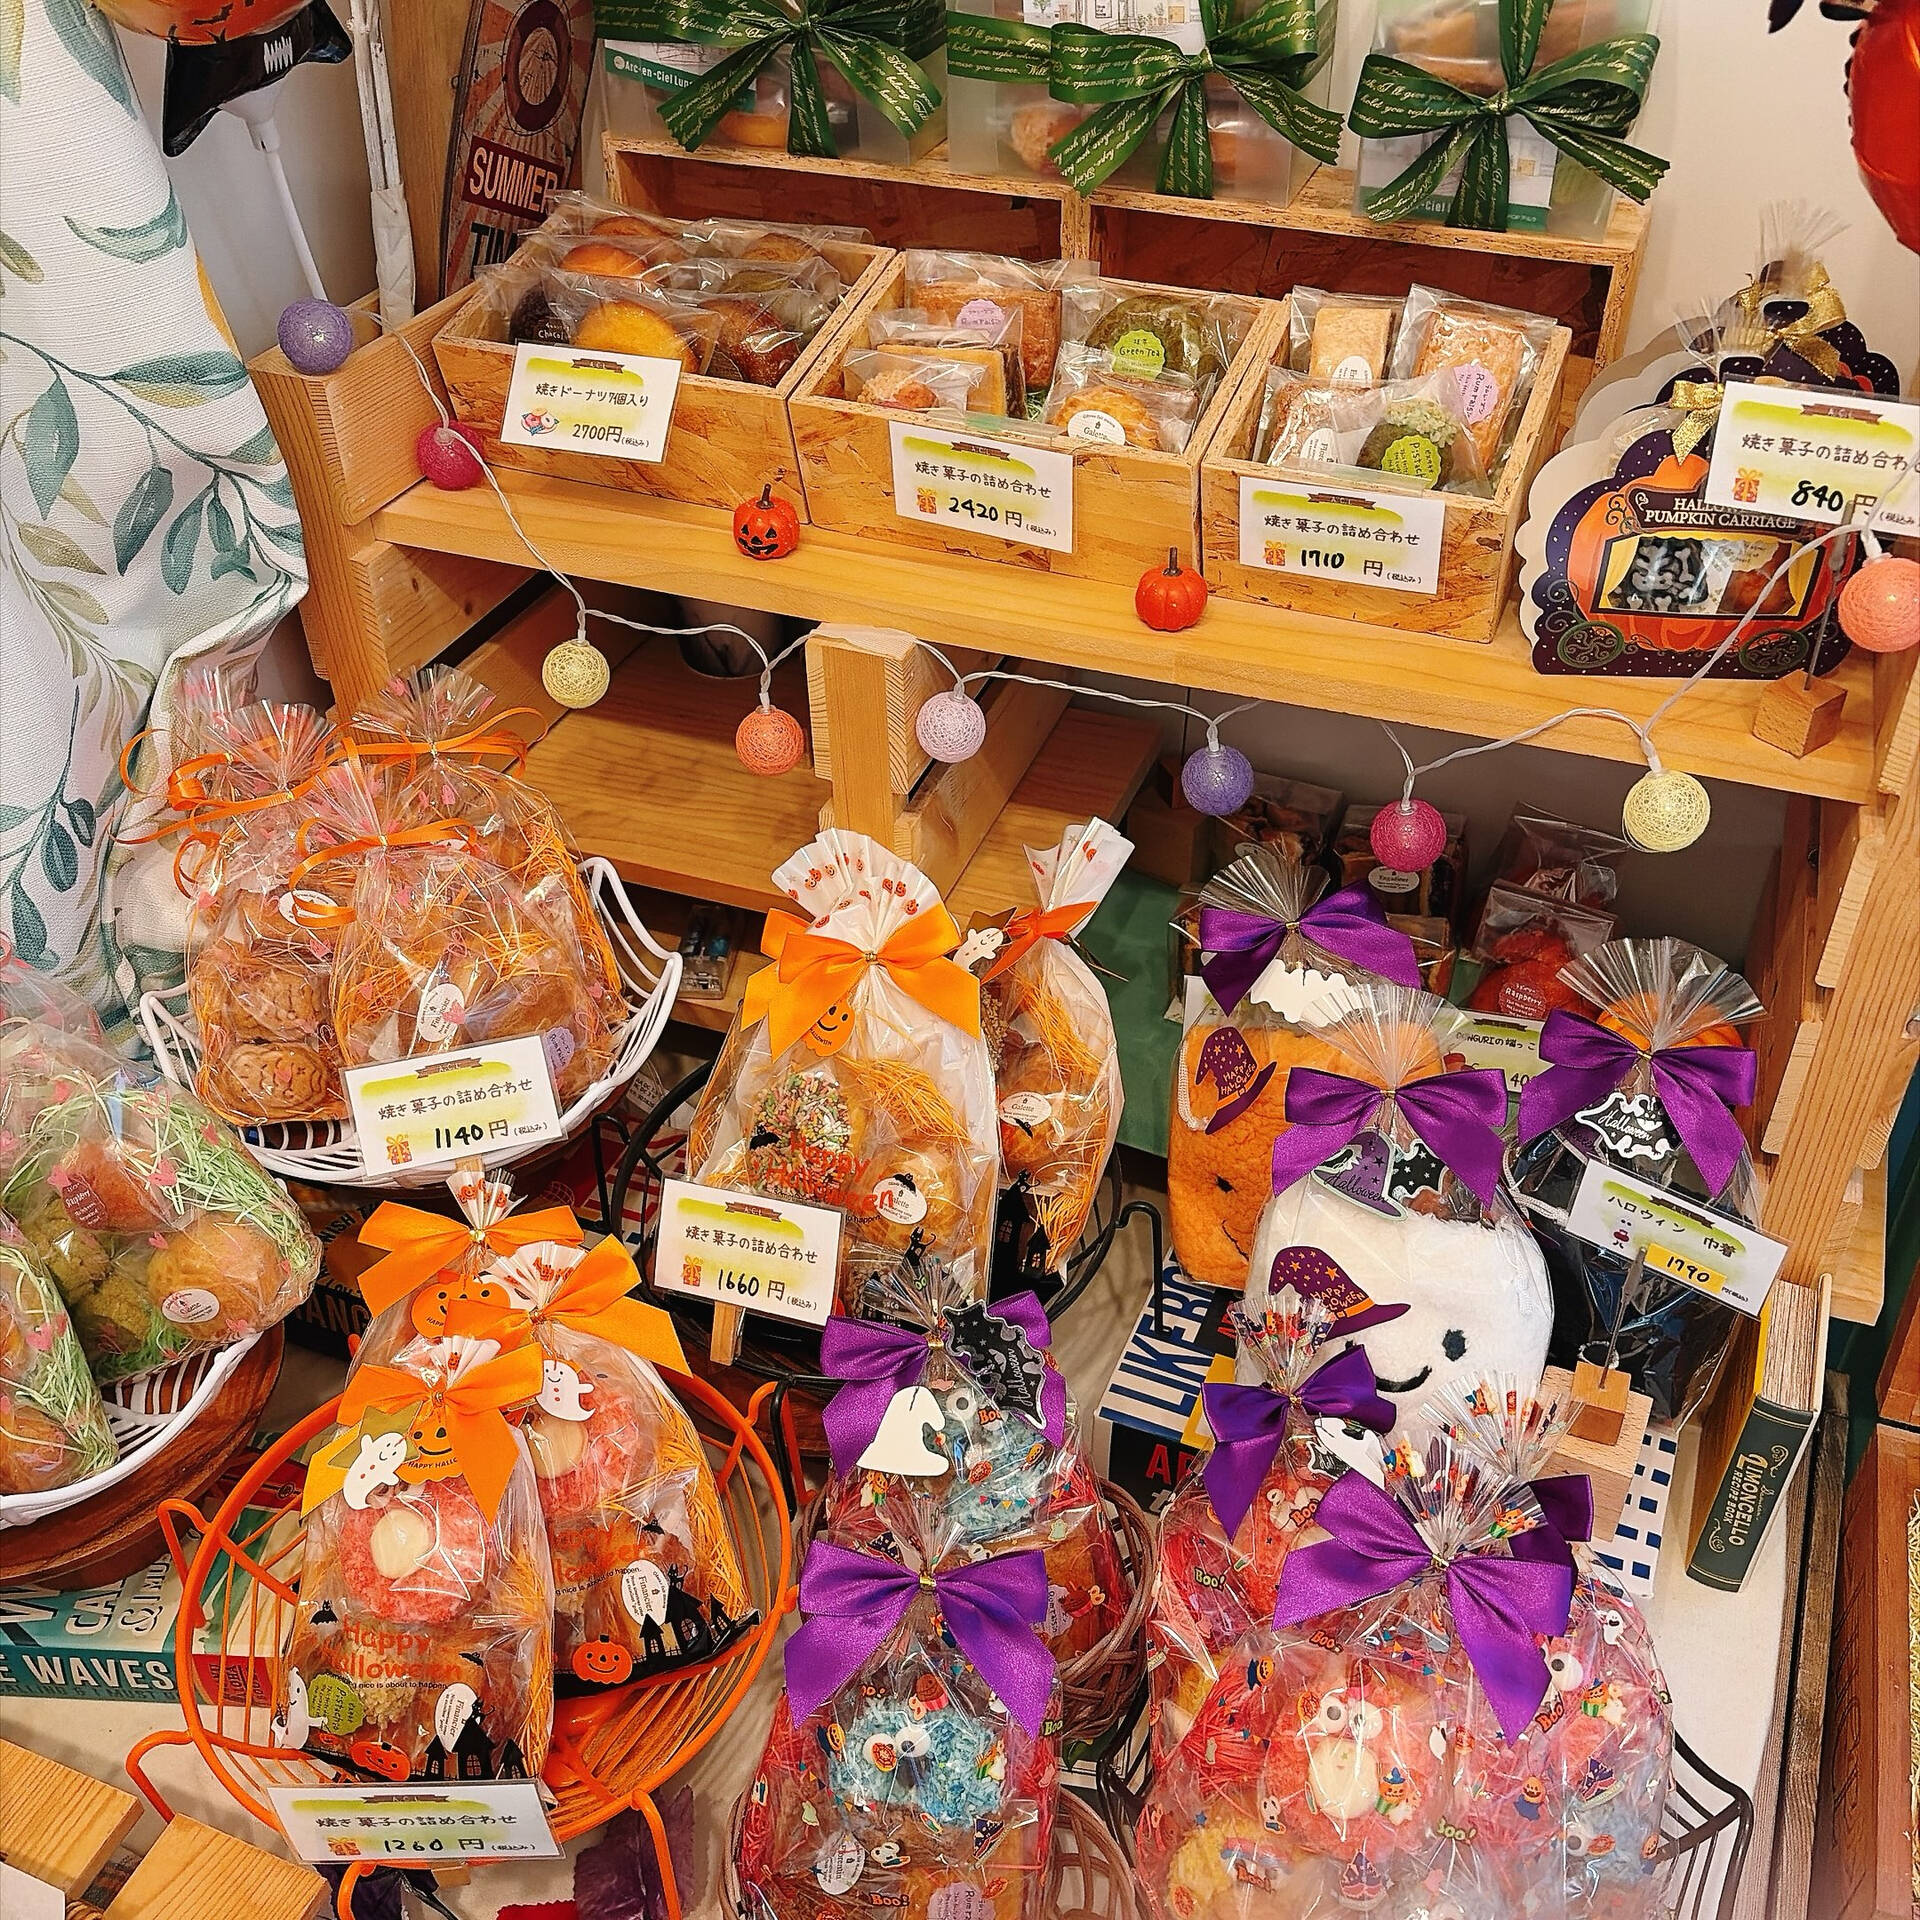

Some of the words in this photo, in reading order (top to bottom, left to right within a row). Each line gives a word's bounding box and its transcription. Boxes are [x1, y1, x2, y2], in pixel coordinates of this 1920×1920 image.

[469, 146, 558, 214] SUMMER
[535, 382, 650, 408] 焼きドーナツ7個入り
[1790, 480, 1844, 512] 840
[1644, 509, 1717, 526] PUMPKIN
[1717, 513, 1798, 531] CARRIAGE
[1301, 550, 1345, 569] 1710
[1505, 986, 1542, 1007] Raspberry
[435, 1124, 484, 1150] 1140
[1597, 1109, 1653, 1141] Halloween
[1323, 1171, 1389, 1204] Halloween
[1607, 1195, 1686, 1234] ハロウィン
[1702, 1236, 1738, 1259] 巾着
[718, 1268, 760, 1297] 1660
[1666, 1256, 1711, 1284] 1790
[1005, 1348, 1034, 1407] Halloween
[1727, 1469, 1744, 1502] RECIPE
[1728, 1453, 1770, 1546] LIMONCELLO
[1722, 1501, 1736, 1524] BOOK
[1194, 1567, 1227, 1592] Boo!
[342, 1614, 433, 1656] Happy
[22, 1654, 175, 1692] WAVES
[384, 1838, 443, 1853] 1260
